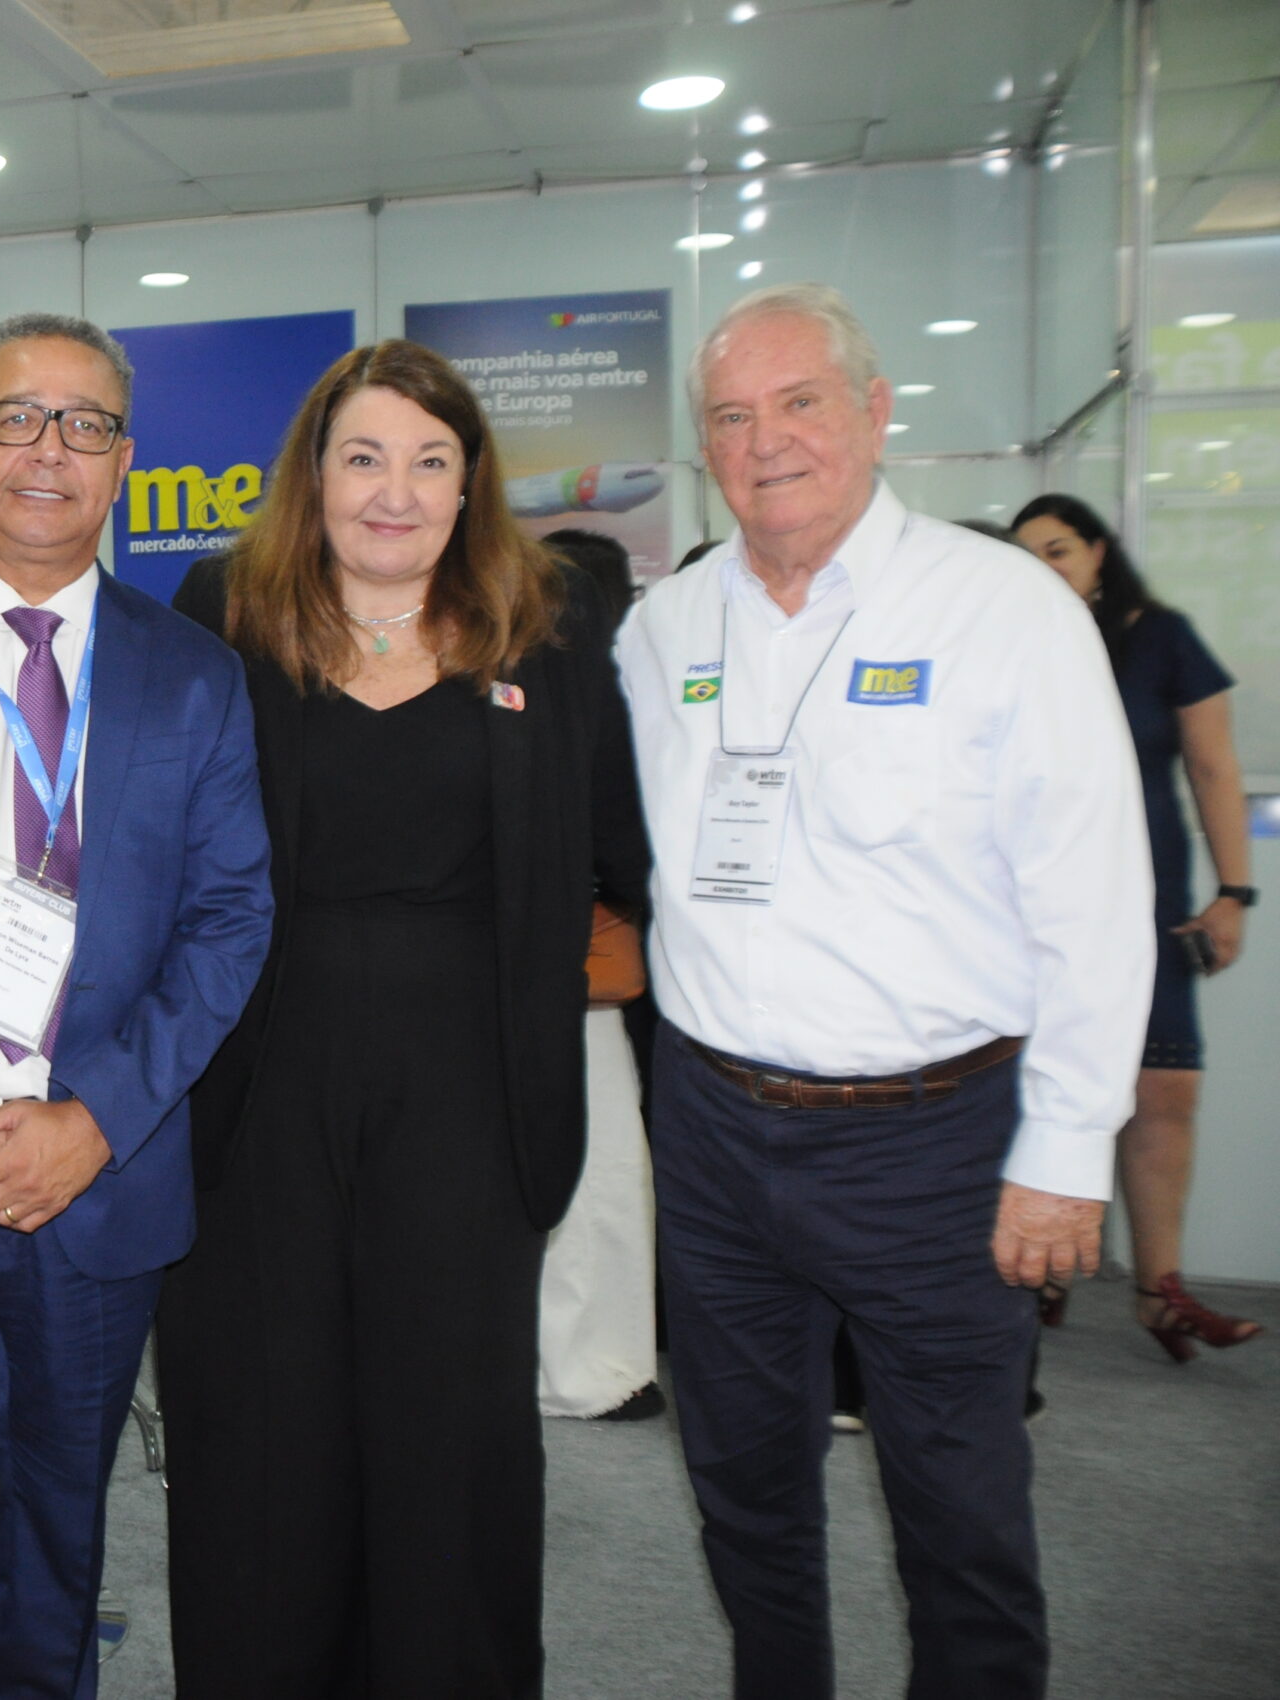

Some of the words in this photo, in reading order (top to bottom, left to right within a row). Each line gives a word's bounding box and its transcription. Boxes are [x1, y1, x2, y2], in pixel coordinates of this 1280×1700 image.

[557, 347, 618, 366] aérea
[490, 373, 541, 391] mais
[545, 372, 583, 388] voa
[588, 368, 649, 386] entre
[497, 392, 574, 413] Europa
